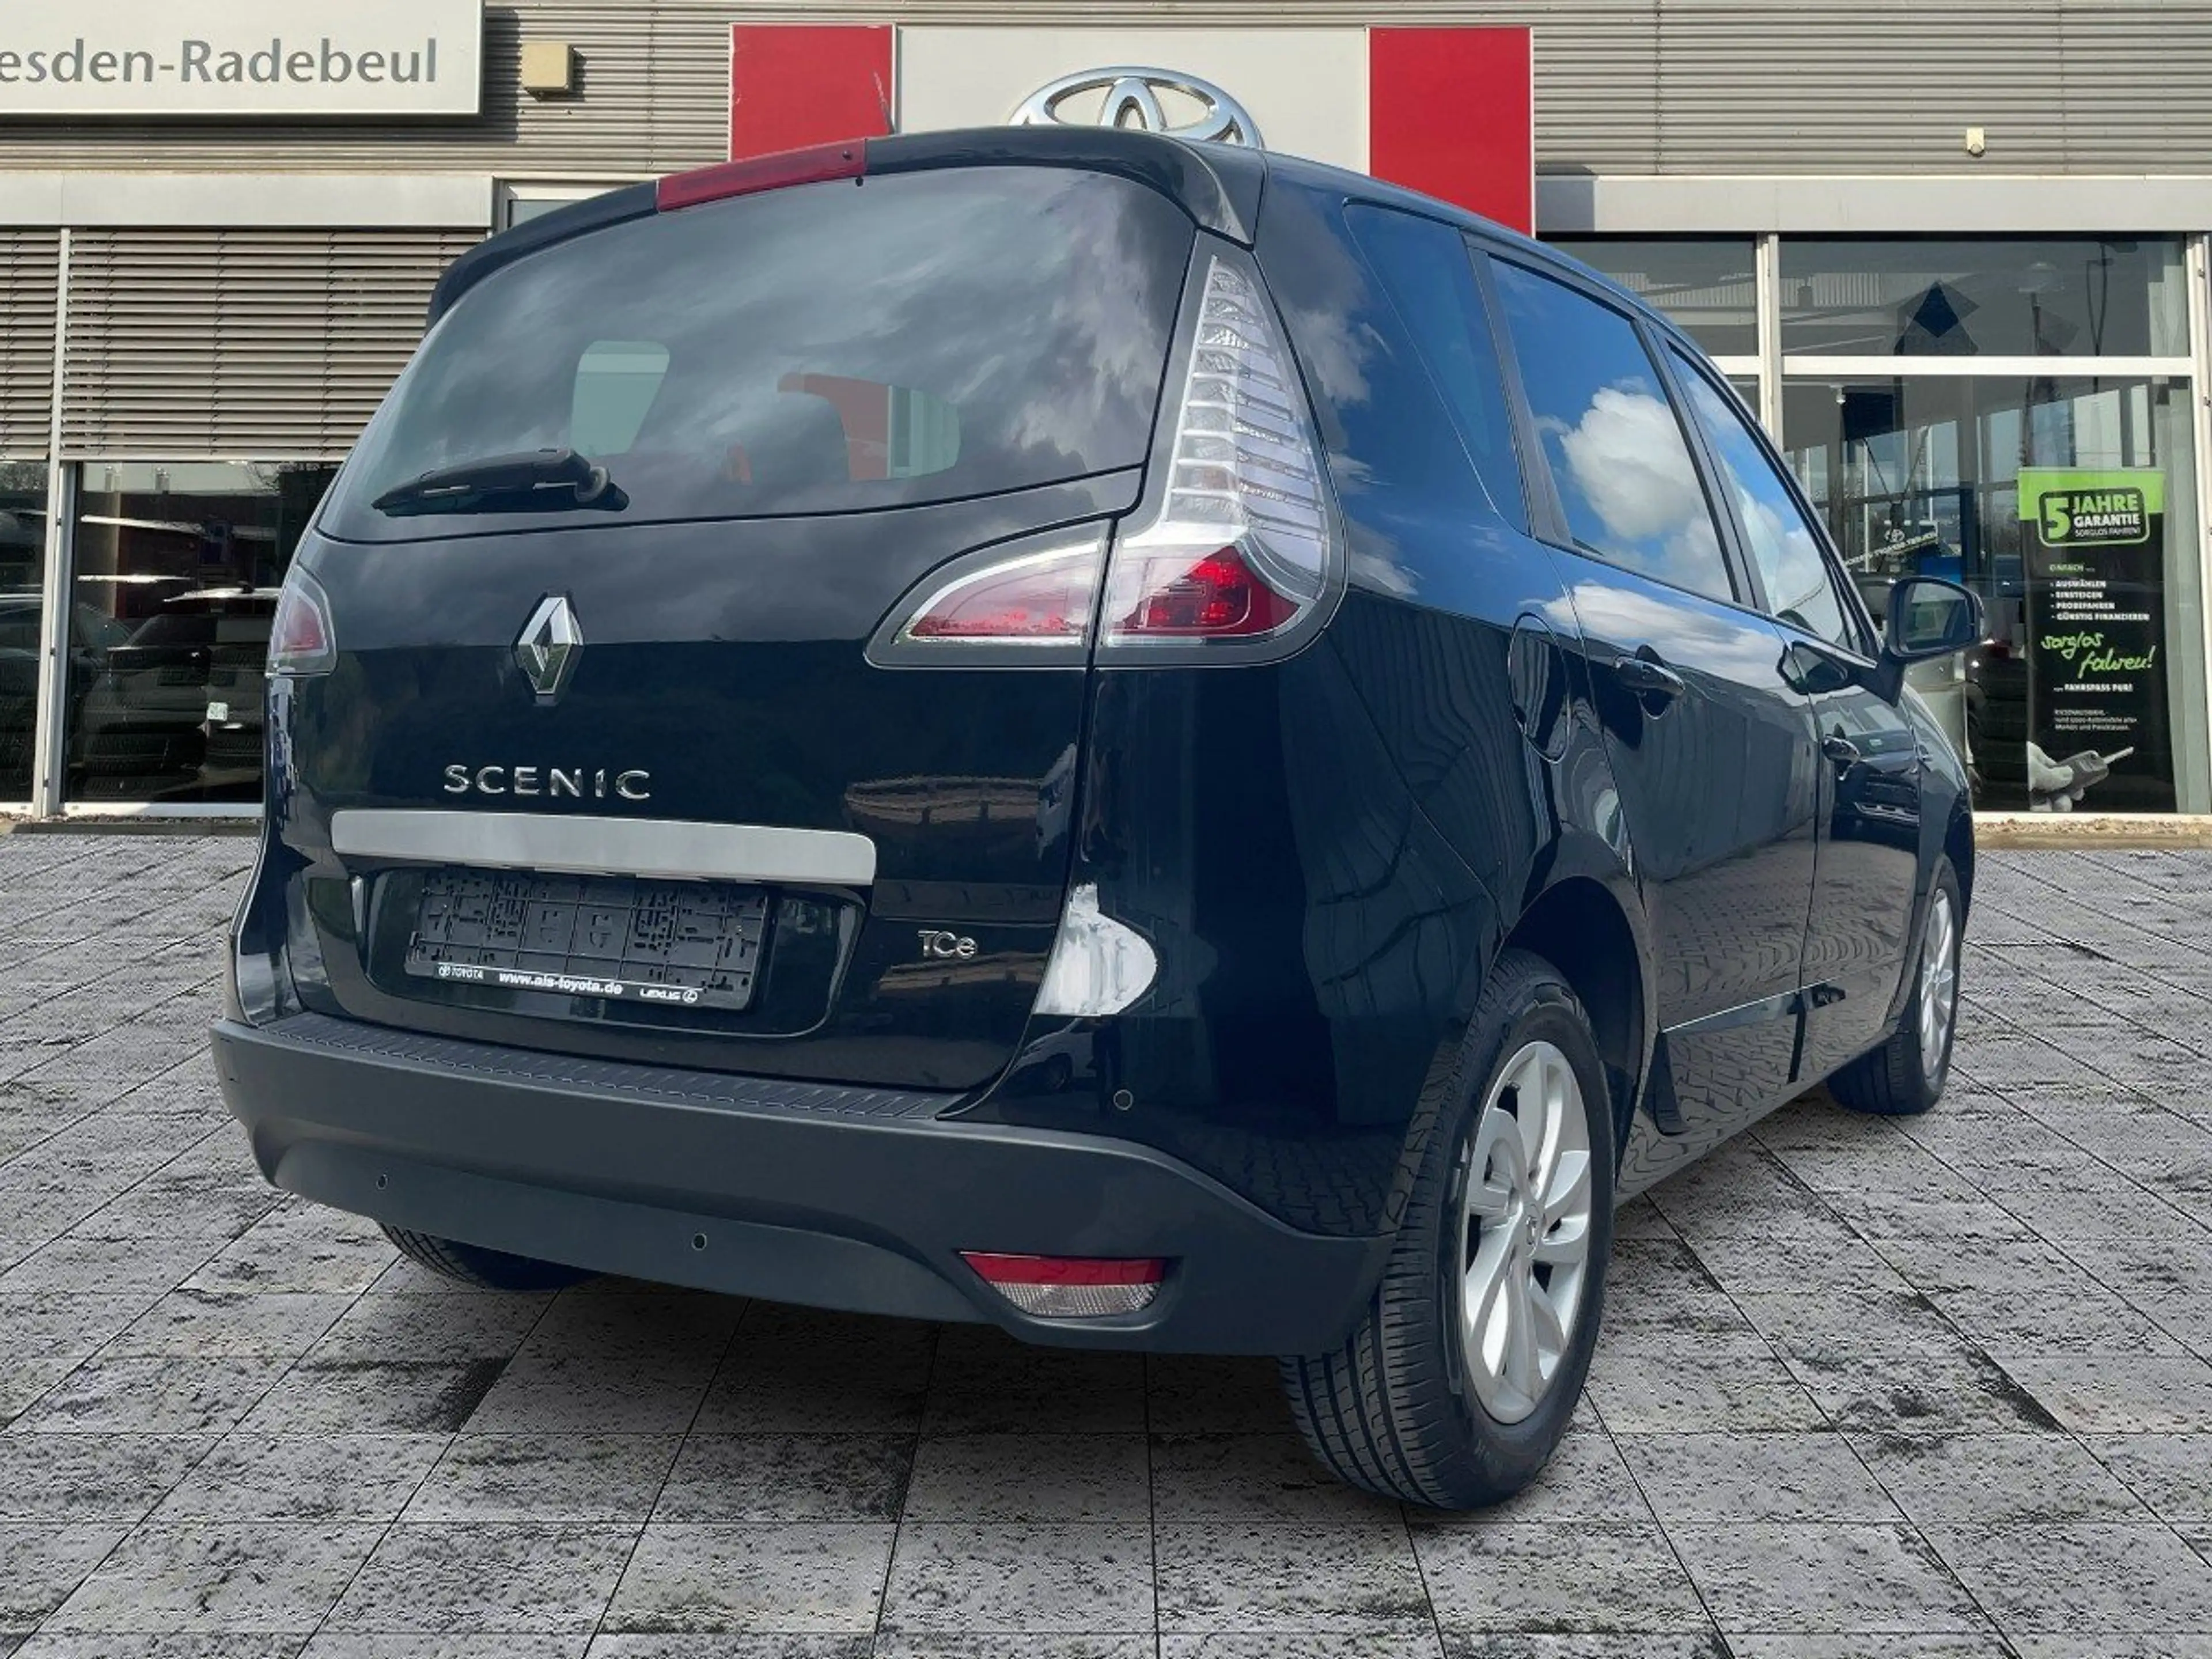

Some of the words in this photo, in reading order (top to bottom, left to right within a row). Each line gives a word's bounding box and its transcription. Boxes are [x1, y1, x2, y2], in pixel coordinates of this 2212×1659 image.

[0, 38, 437, 83] esden-Radebeul
[2046, 497, 2071, 539] 5
[2072, 493, 2139, 514] JAHRE
[2074, 513, 2141, 528] GARANTIE
[2040, 631, 2104, 660] sorglos
[444, 764, 651, 800] SCENIC
[917, 930, 978, 960] TCe
[452, 967, 484, 979] TOYOTA
